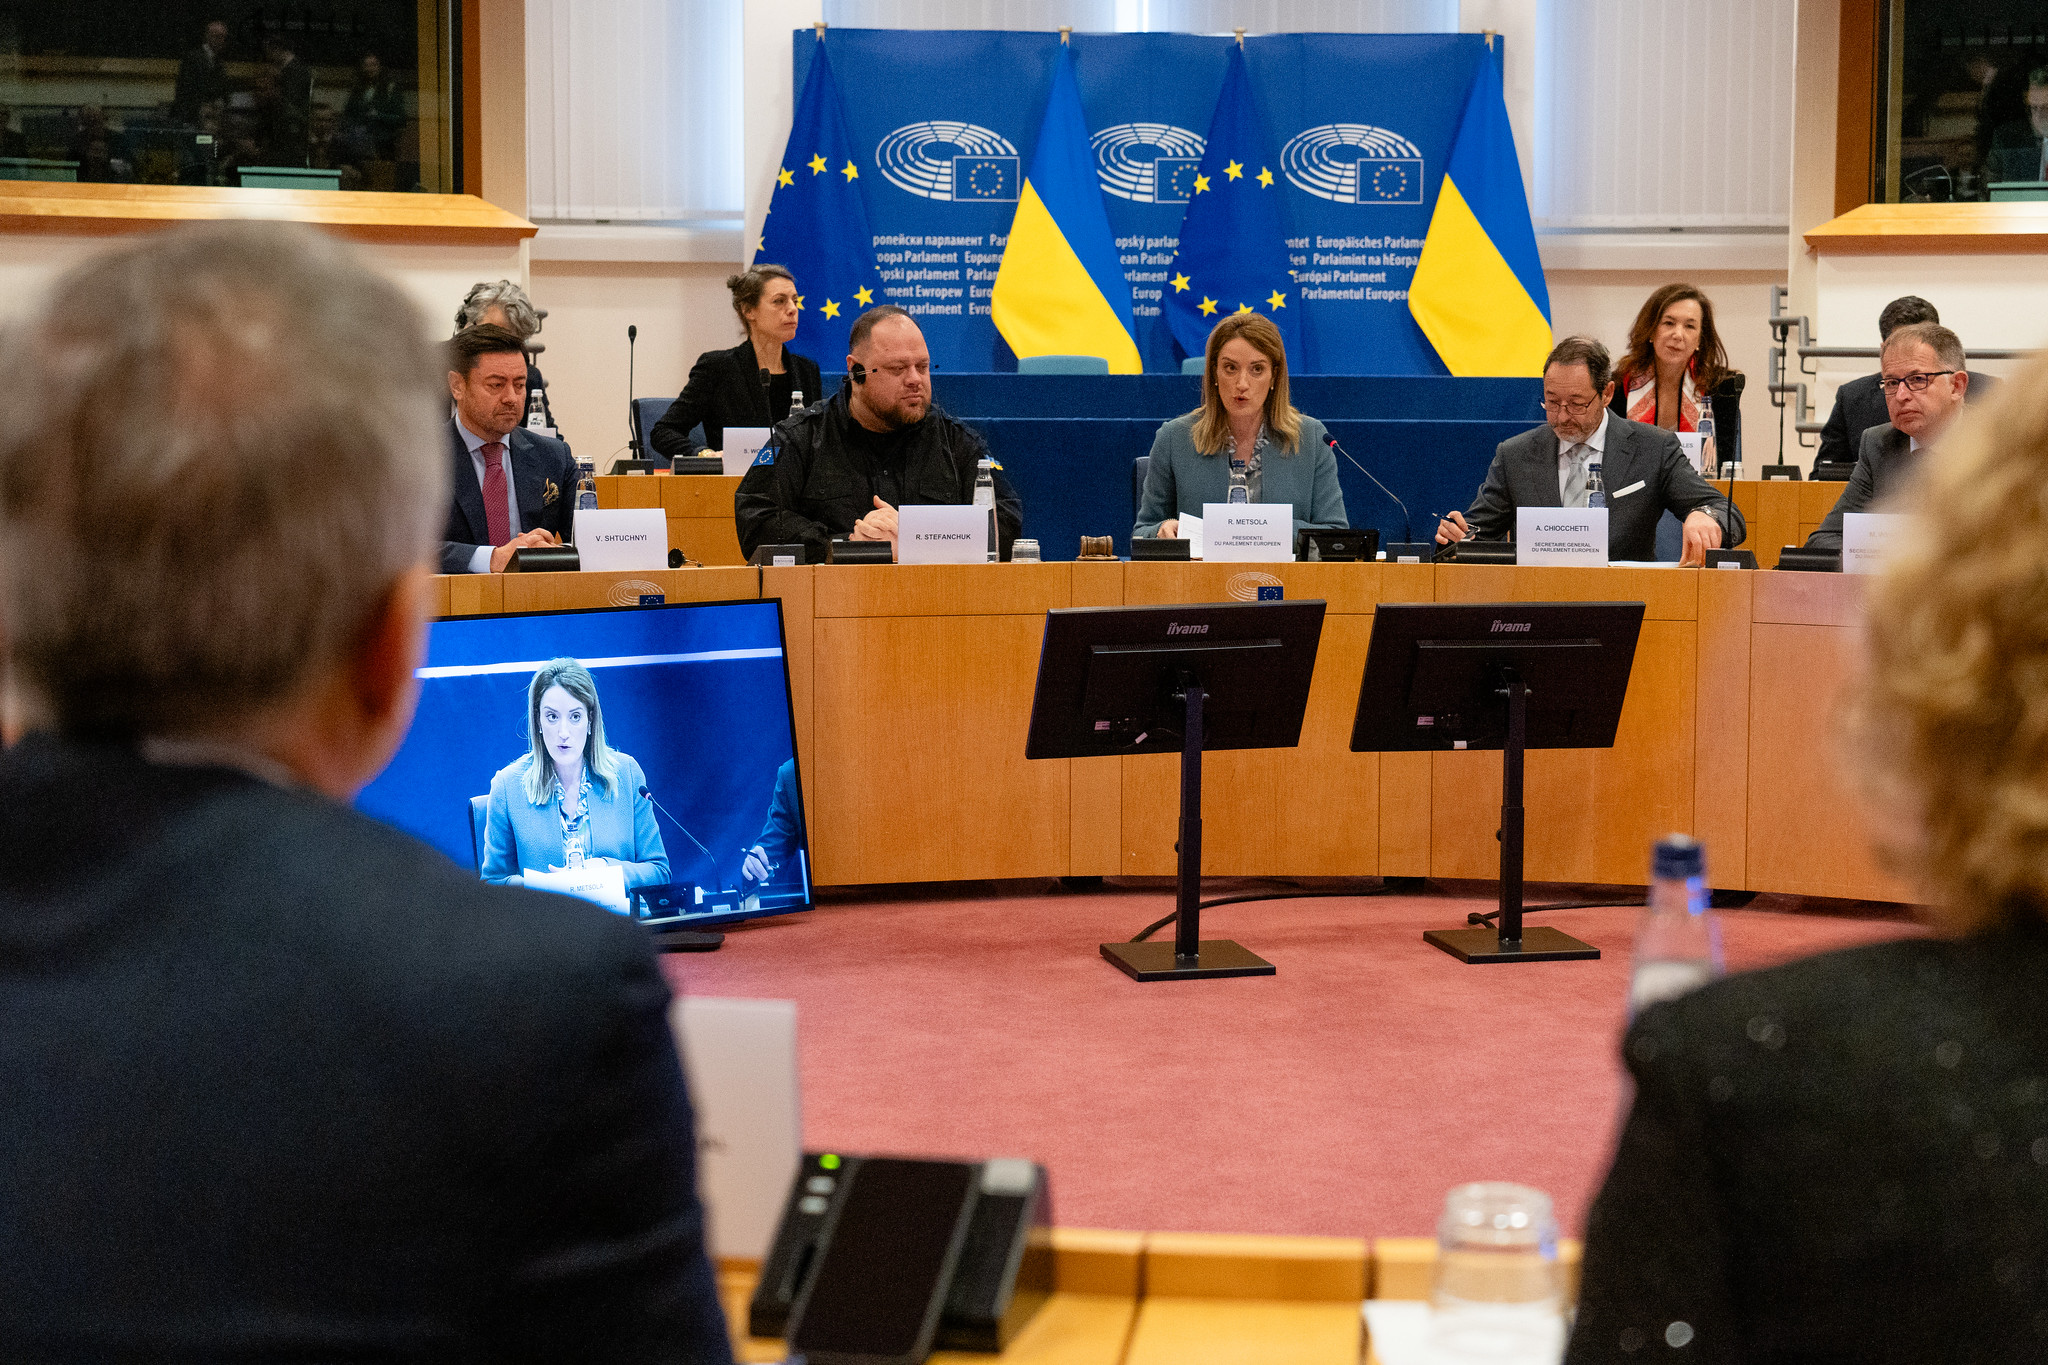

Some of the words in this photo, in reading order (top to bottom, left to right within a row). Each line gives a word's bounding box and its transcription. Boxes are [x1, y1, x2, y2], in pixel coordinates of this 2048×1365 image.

[925, 236, 983, 249] парламент
[1316, 235, 1383, 251] Europäisches
[905, 250, 958, 263] Parlament
[1313, 253, 1366, 265] Parlaimint
[1368, 256, 1381, 265] na
[906, 267, 960, 283] parlament
[1333, 270, 1386, 283] Parlament
[915, 285, 963, 300] Ewropew
[1302, 287, 1364, 300] Parlamentul
[1365, 287, 1409, 302] Europea
[908, 302, 962, 315] parlament
[1166, 622, 1209, 635] iiyama
[1490, 619, 1531, 632] iiyama
[576, 883, 604, 892] METSOLA
